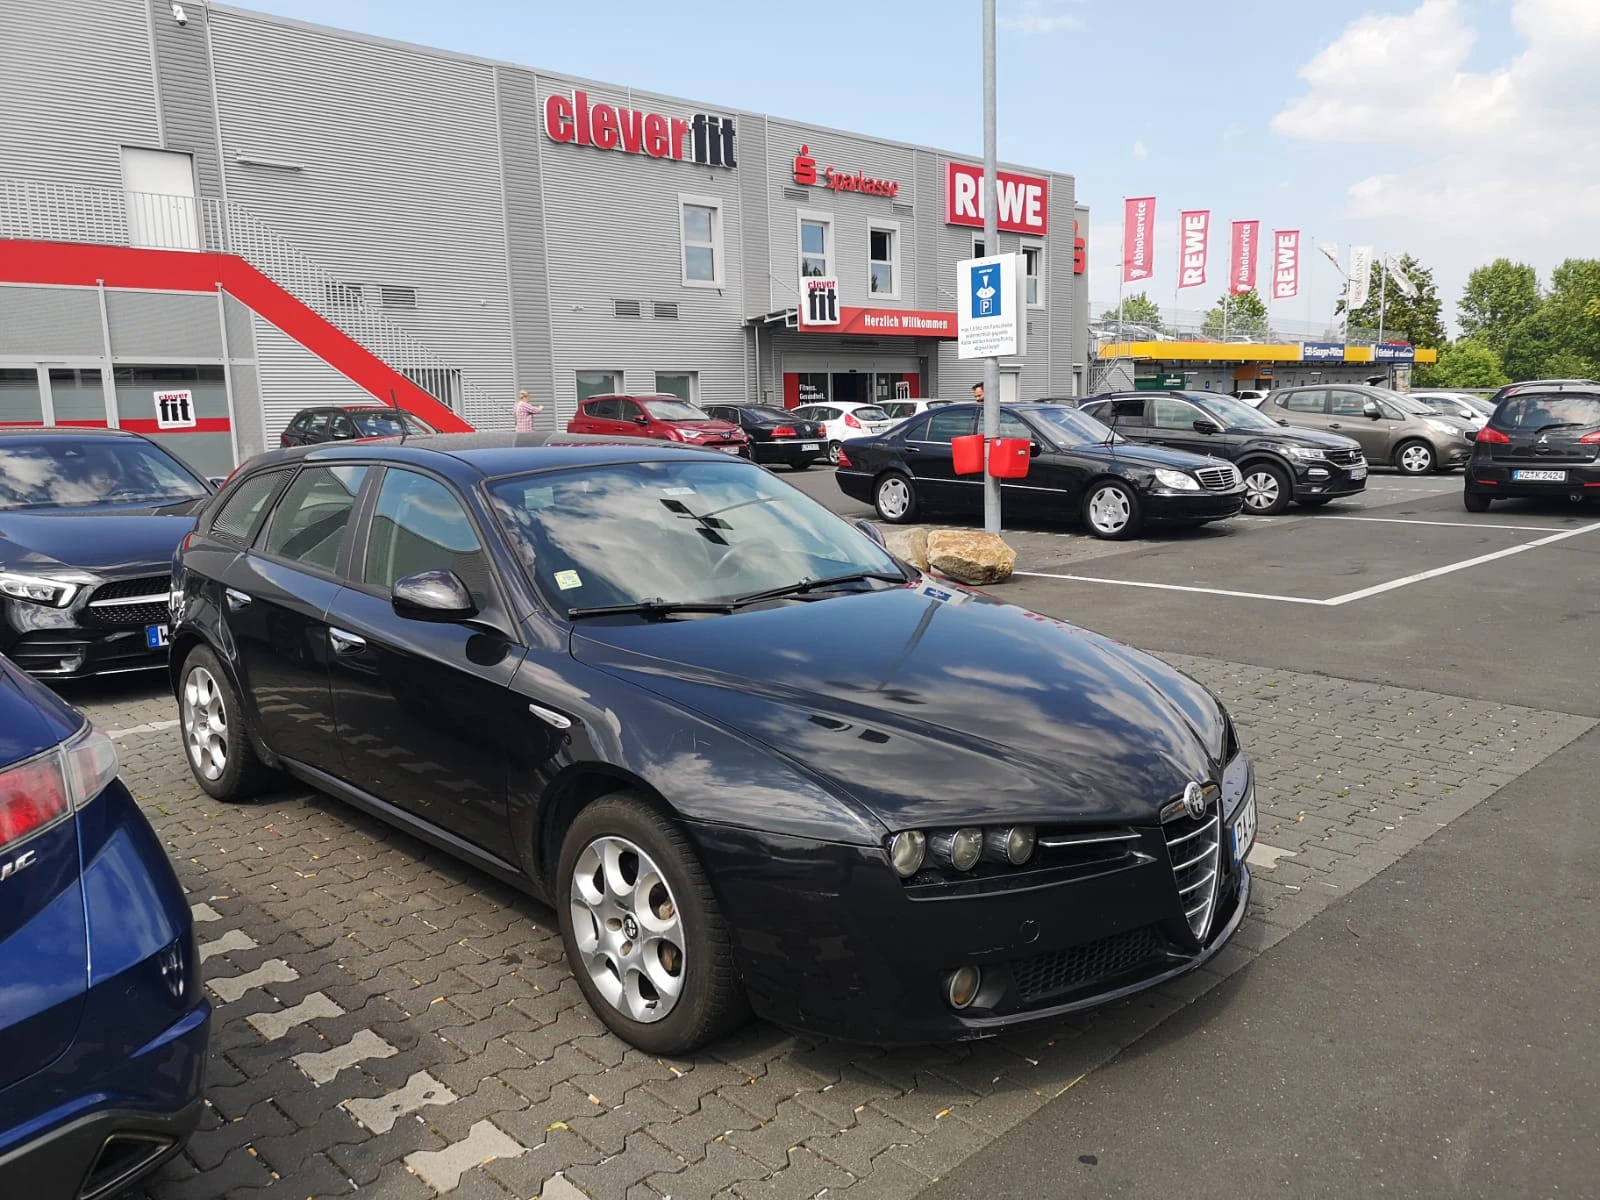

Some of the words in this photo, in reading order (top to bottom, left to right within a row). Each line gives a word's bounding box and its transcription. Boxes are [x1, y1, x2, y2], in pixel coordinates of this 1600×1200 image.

[544, 90, 688, 160] clever
[689, 114, 737, 168] fit
[824, 166, 899, 198] Sparkasse
[1133, 201, 1146, 266] Abholservice
[1183, 214, 1206, 285] REWE
[1239, 223, 1251, 281] Abholservice
[807, 280, 836, 289] clever
[1276, 234, 1296, 297] REWE
[808, 288, 837, 321] fit
[864, 314, 899, 328] Herzlich
[902, 315, 948, 329] Willkommen
[160, 399, 191, 421] fit
